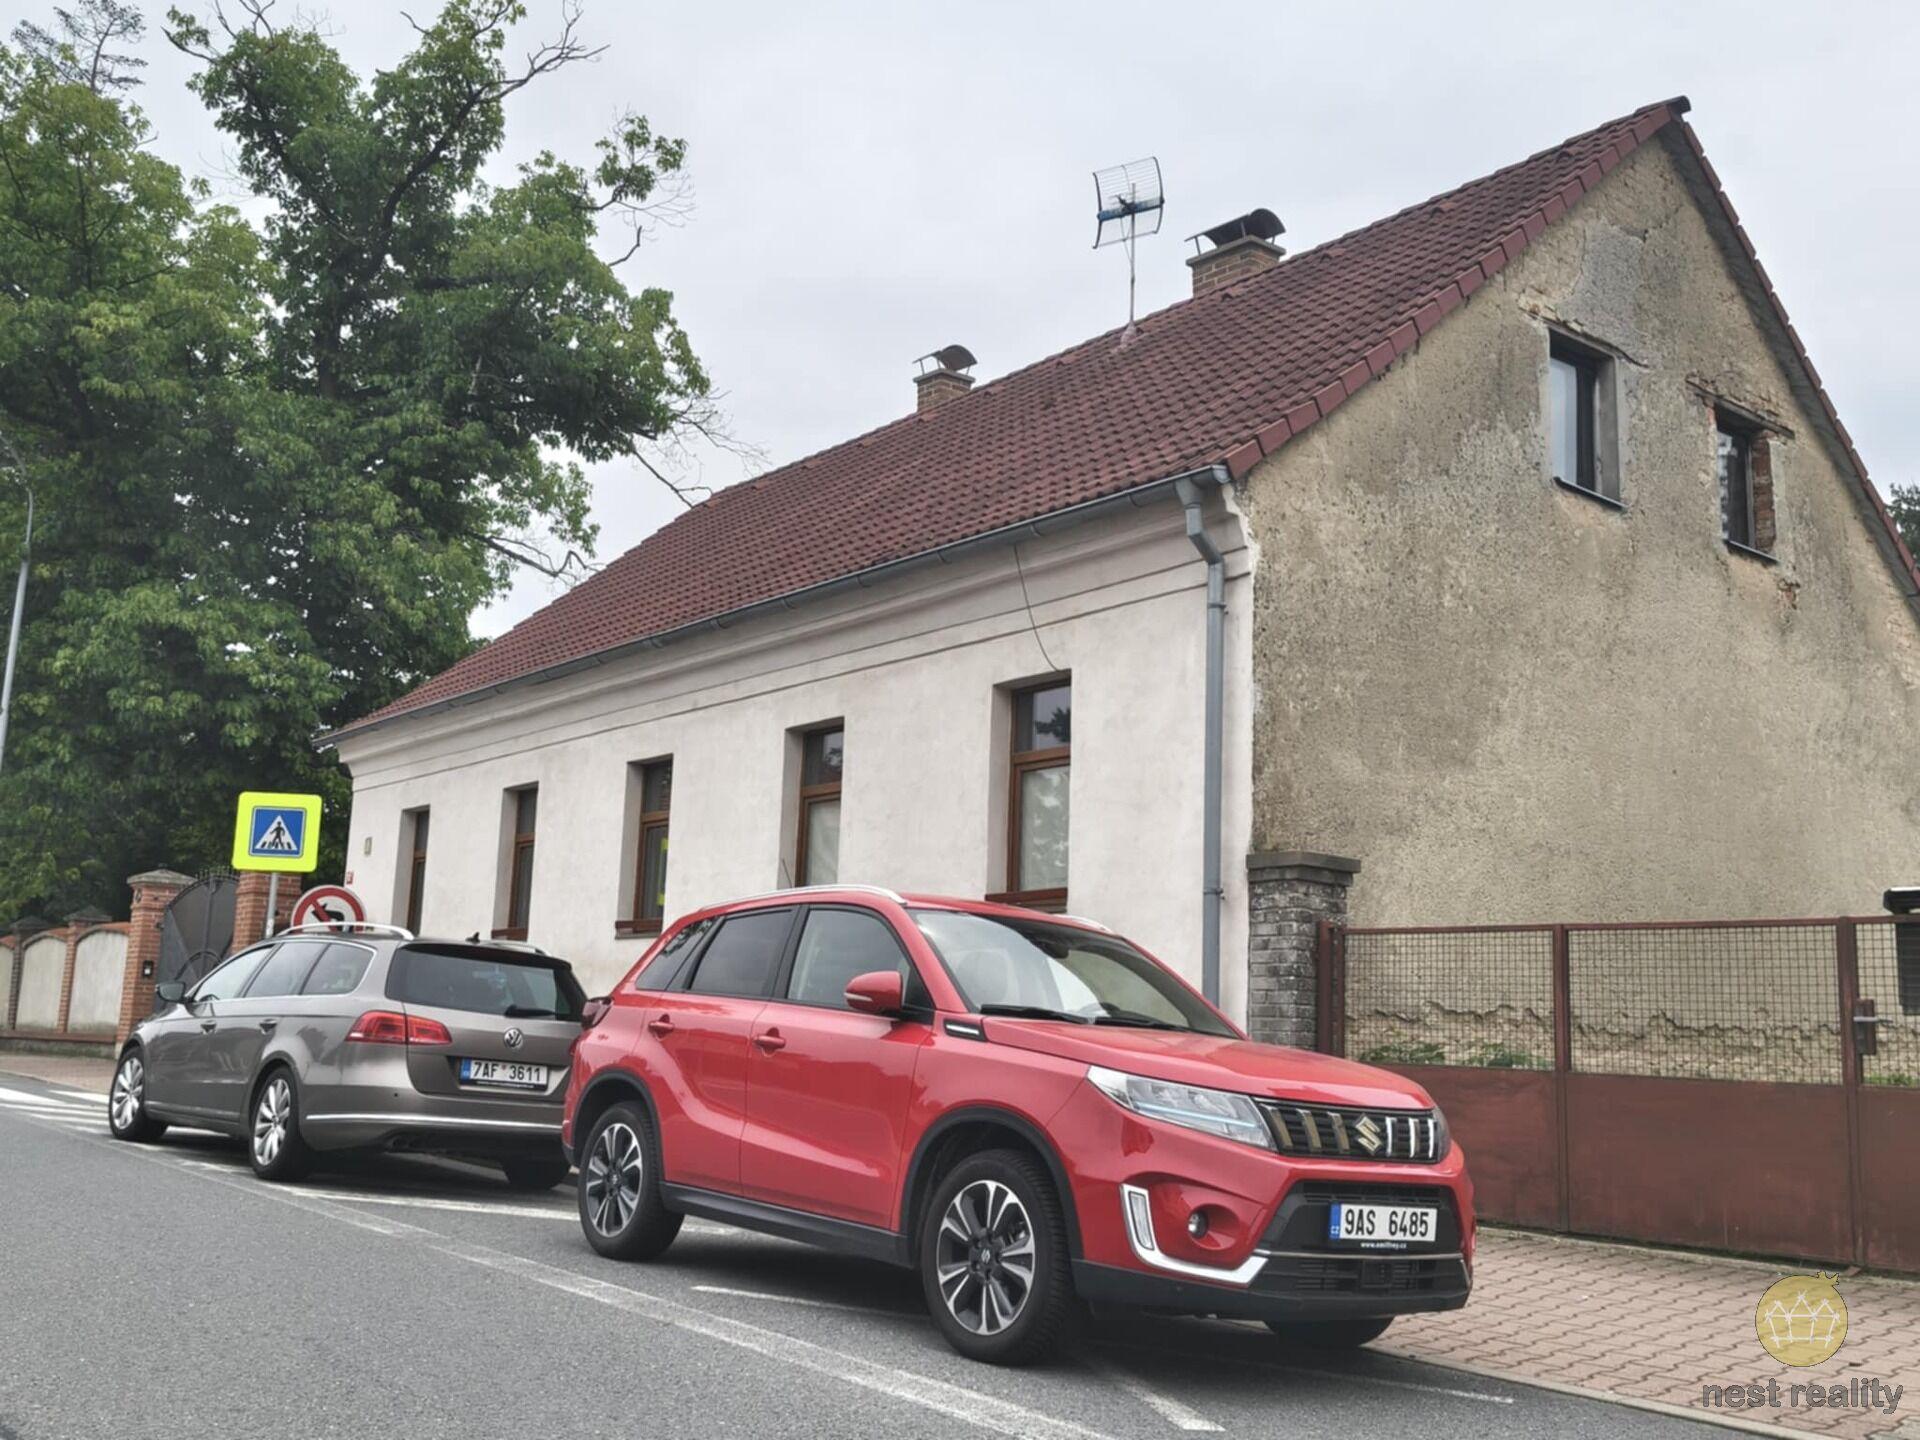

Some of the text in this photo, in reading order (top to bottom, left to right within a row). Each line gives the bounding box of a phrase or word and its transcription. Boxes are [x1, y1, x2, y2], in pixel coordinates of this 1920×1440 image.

[474, 1061, 540, 1082] 7AF 3611
[1344, 1208, 1429, 1237] 9AS 6485
